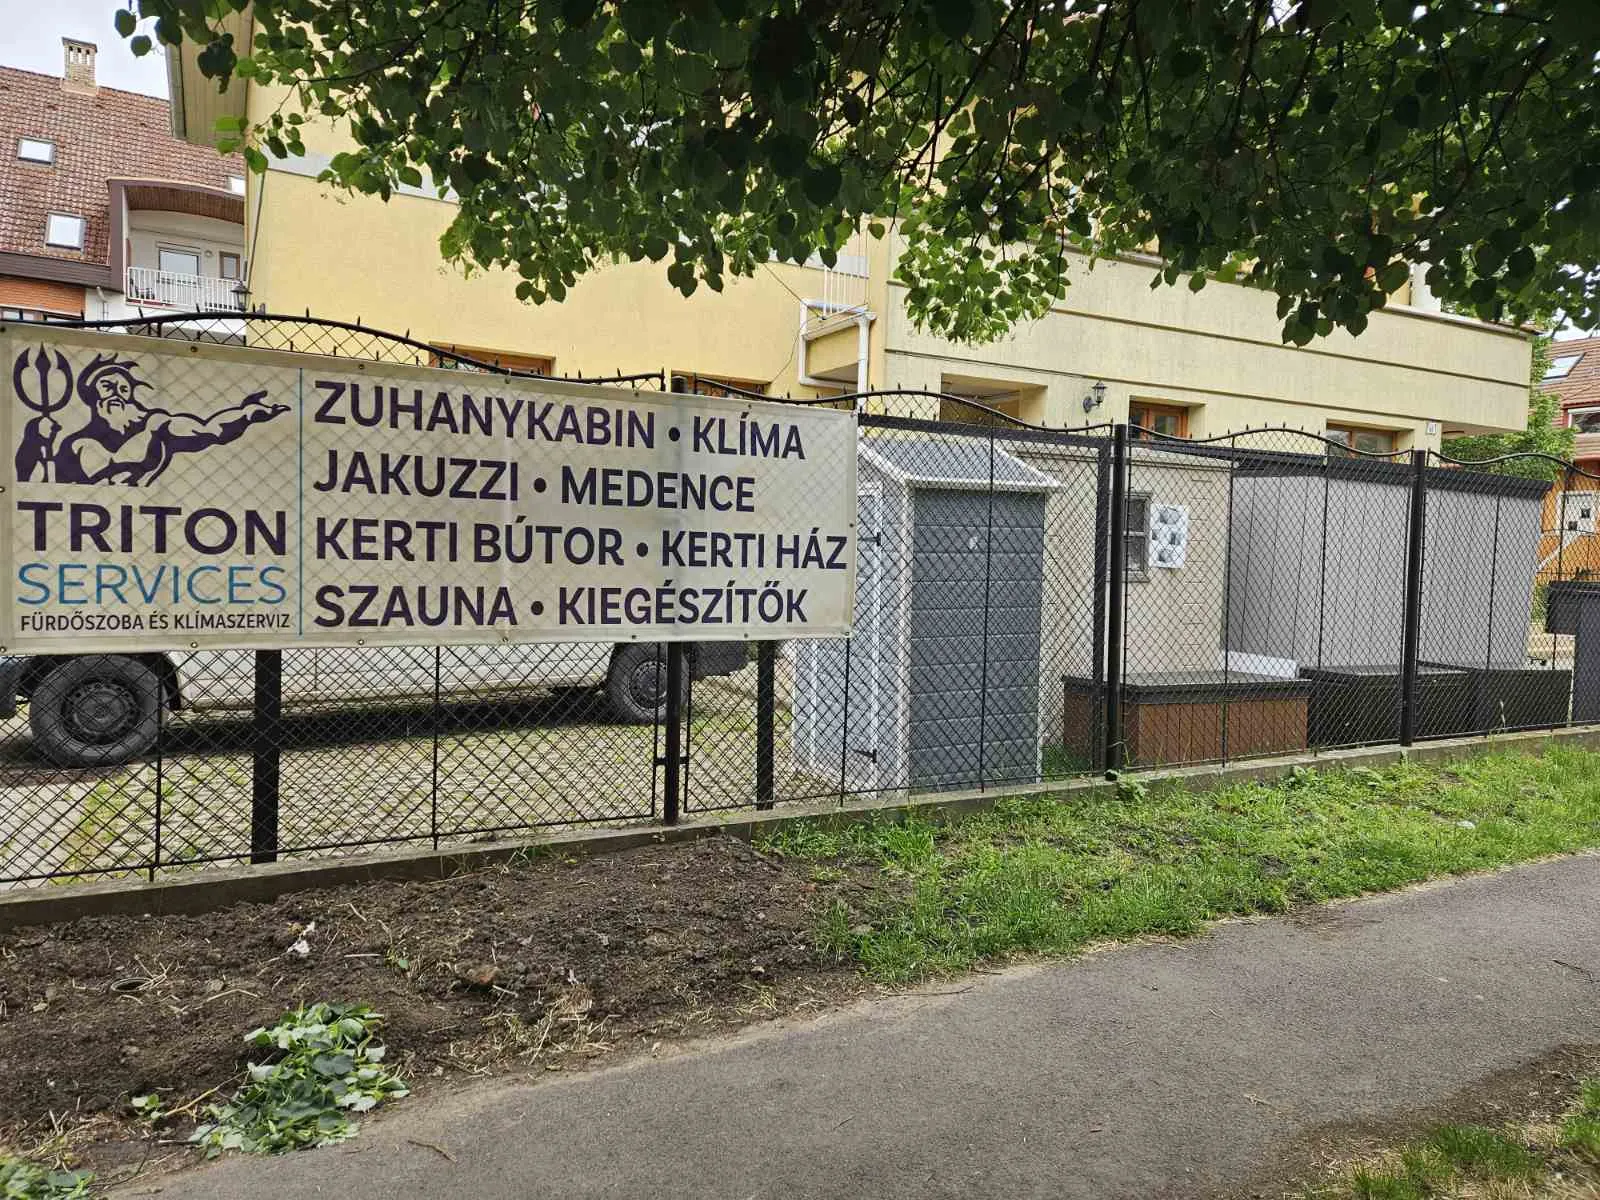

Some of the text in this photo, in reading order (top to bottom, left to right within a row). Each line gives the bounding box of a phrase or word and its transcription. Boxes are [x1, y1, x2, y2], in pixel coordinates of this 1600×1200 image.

[314, 381, 806, 459] ZUHANYKABIN KLÍMA
[313, 450, 756, 512] JAKUZZI MEDENCE
[17, 501, 286, 556] TRITON
[316, 515, 848, 570] KERTI BÚTOR KERTI HÁZ
[17, 563, 287, 605] SERVICES
[313, 579, 808, 628] SZAUNA KIEGÉSZÍTŐK
[20, 609, 290, 632] FÜRDŐSZOBA ÉS KLÍMASZERVIZ
